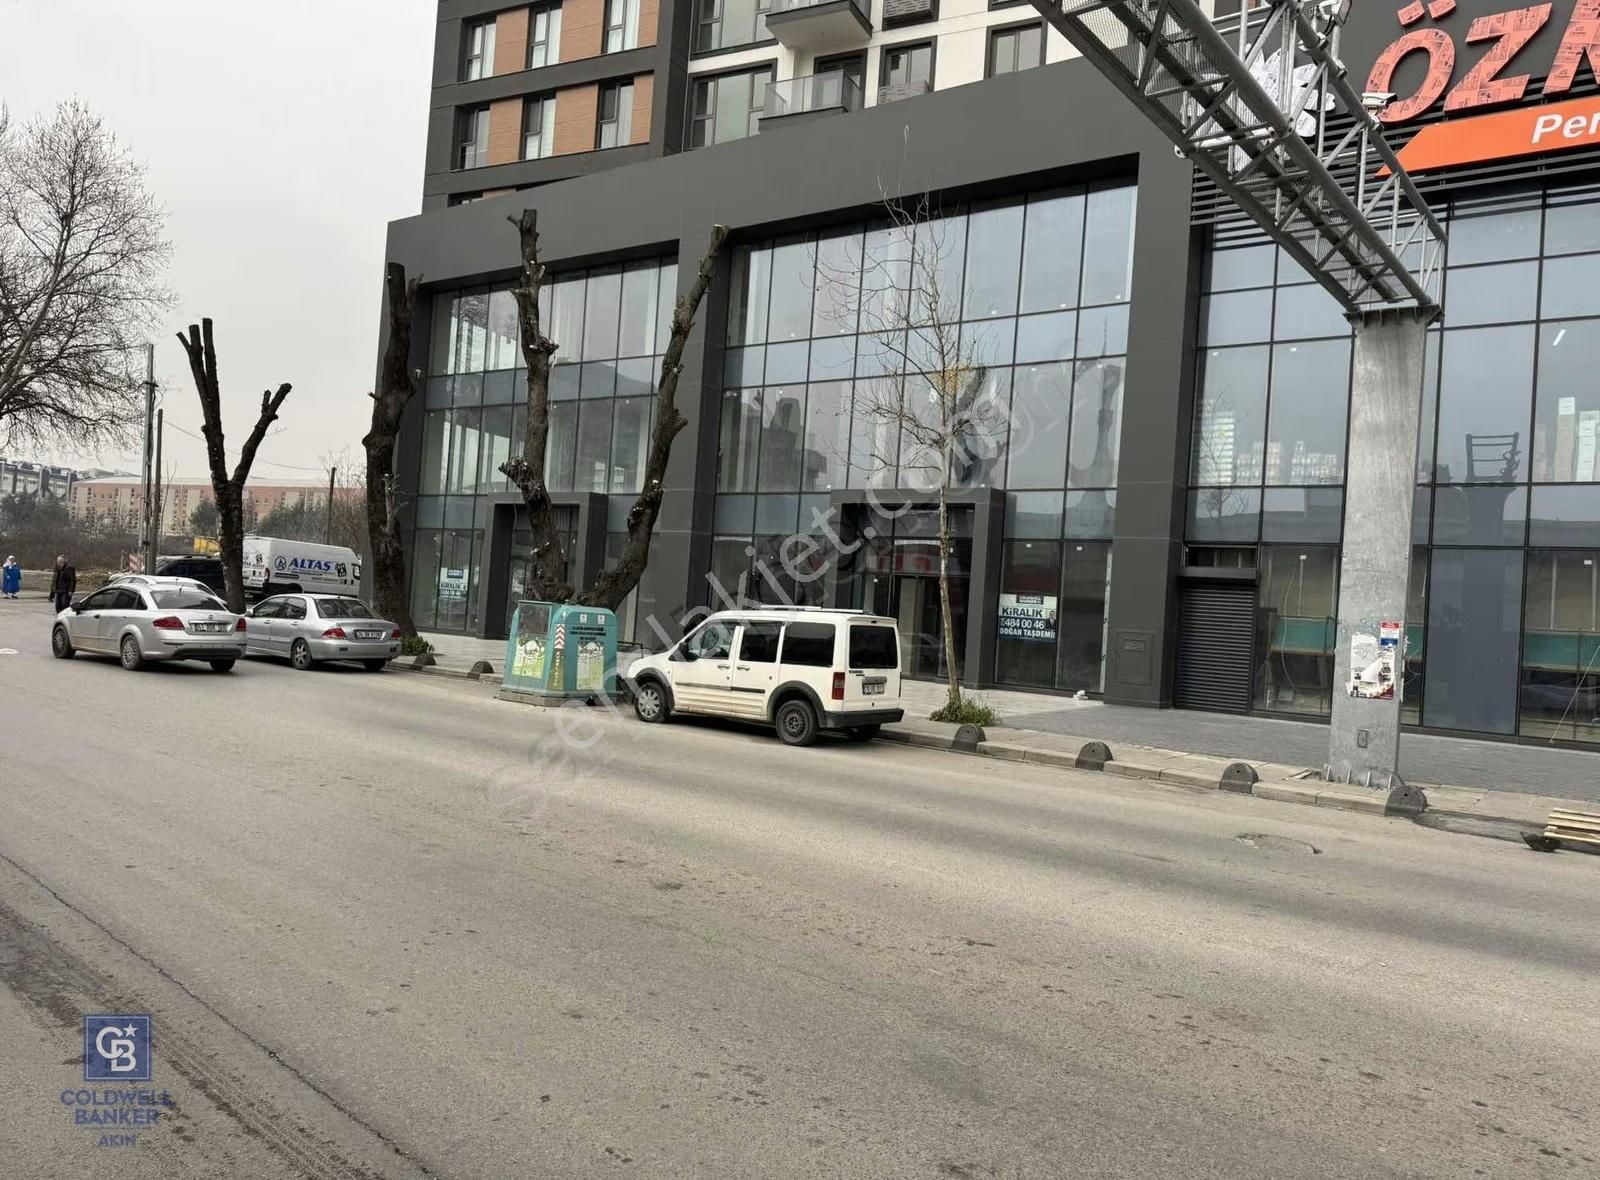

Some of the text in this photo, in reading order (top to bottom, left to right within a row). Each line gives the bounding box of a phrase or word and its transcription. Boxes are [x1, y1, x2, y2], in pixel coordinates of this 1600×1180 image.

[1005, 618, 1020, 628] 484
[1021, 619, 1032, 629] 00
[1033, 620, 1045, 630] 46
